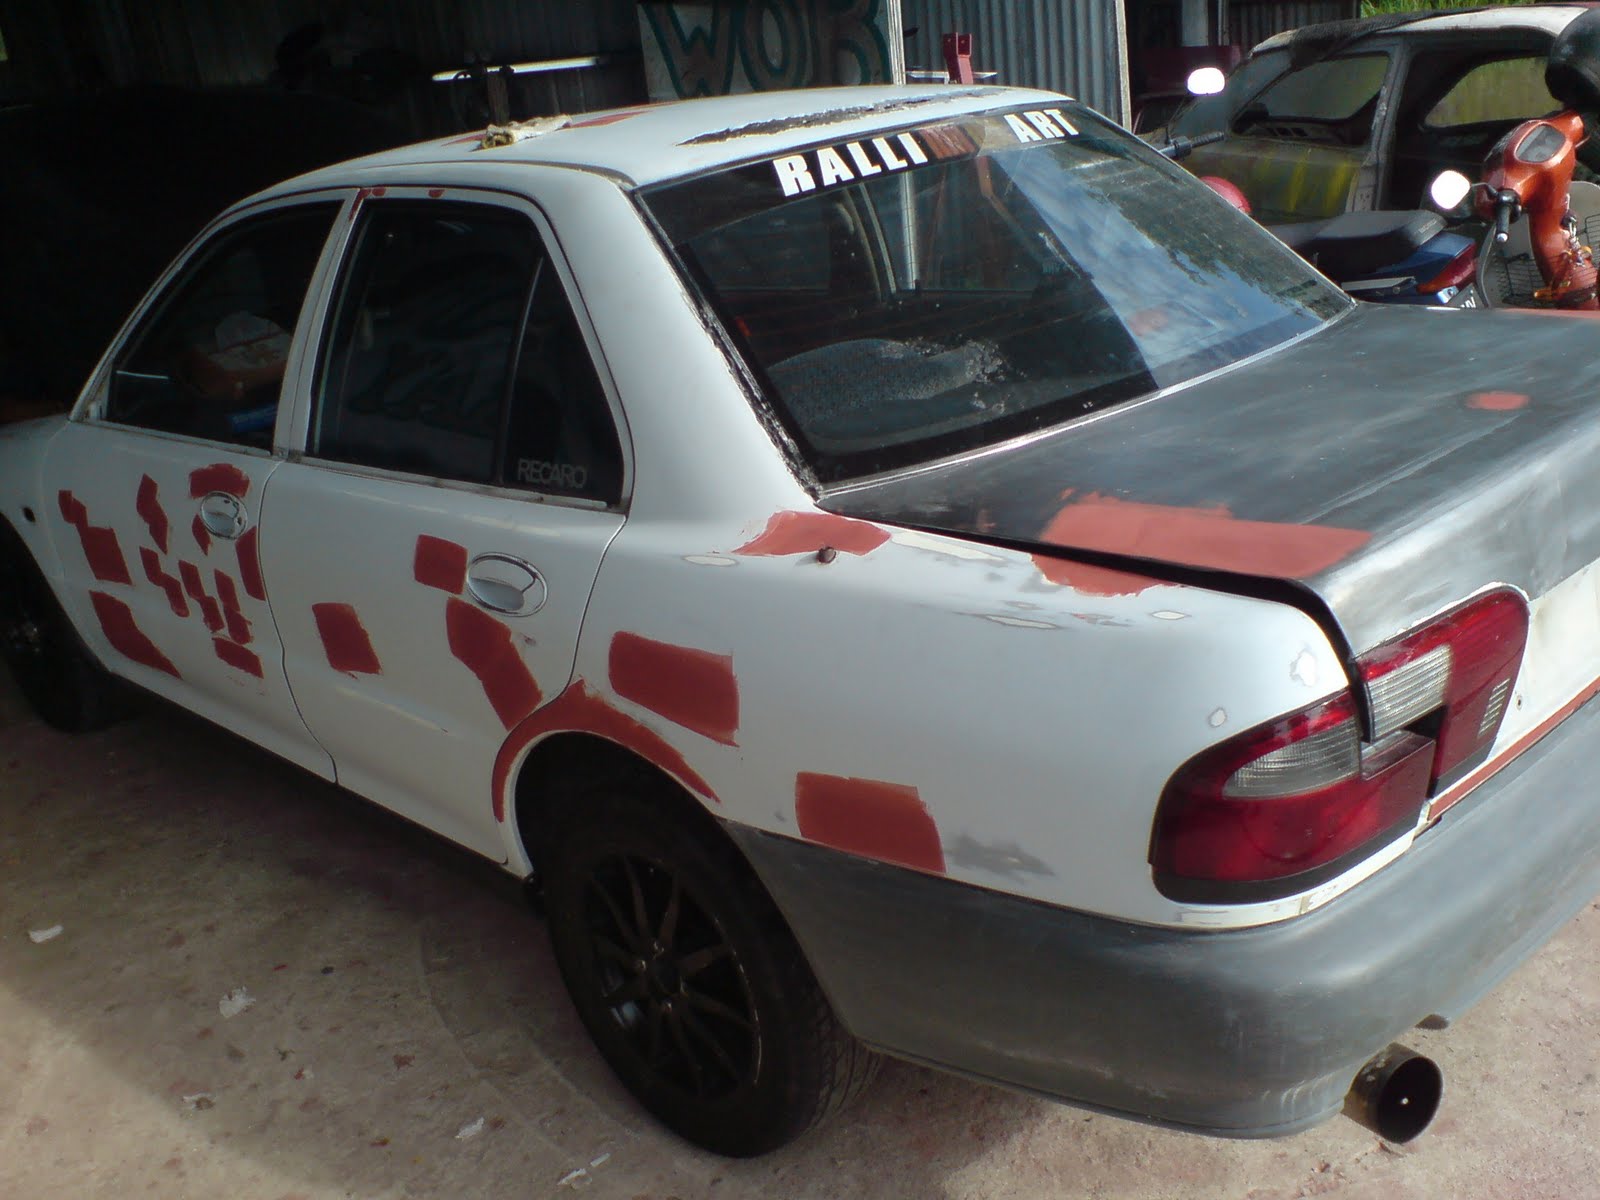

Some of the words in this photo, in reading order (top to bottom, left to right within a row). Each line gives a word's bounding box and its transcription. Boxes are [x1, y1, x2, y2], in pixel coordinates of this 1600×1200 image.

[773, 132, 928, 197] RALLI
[1003, 109, 1080, 144] ART
[517, 458, 588, 489] RECARO
